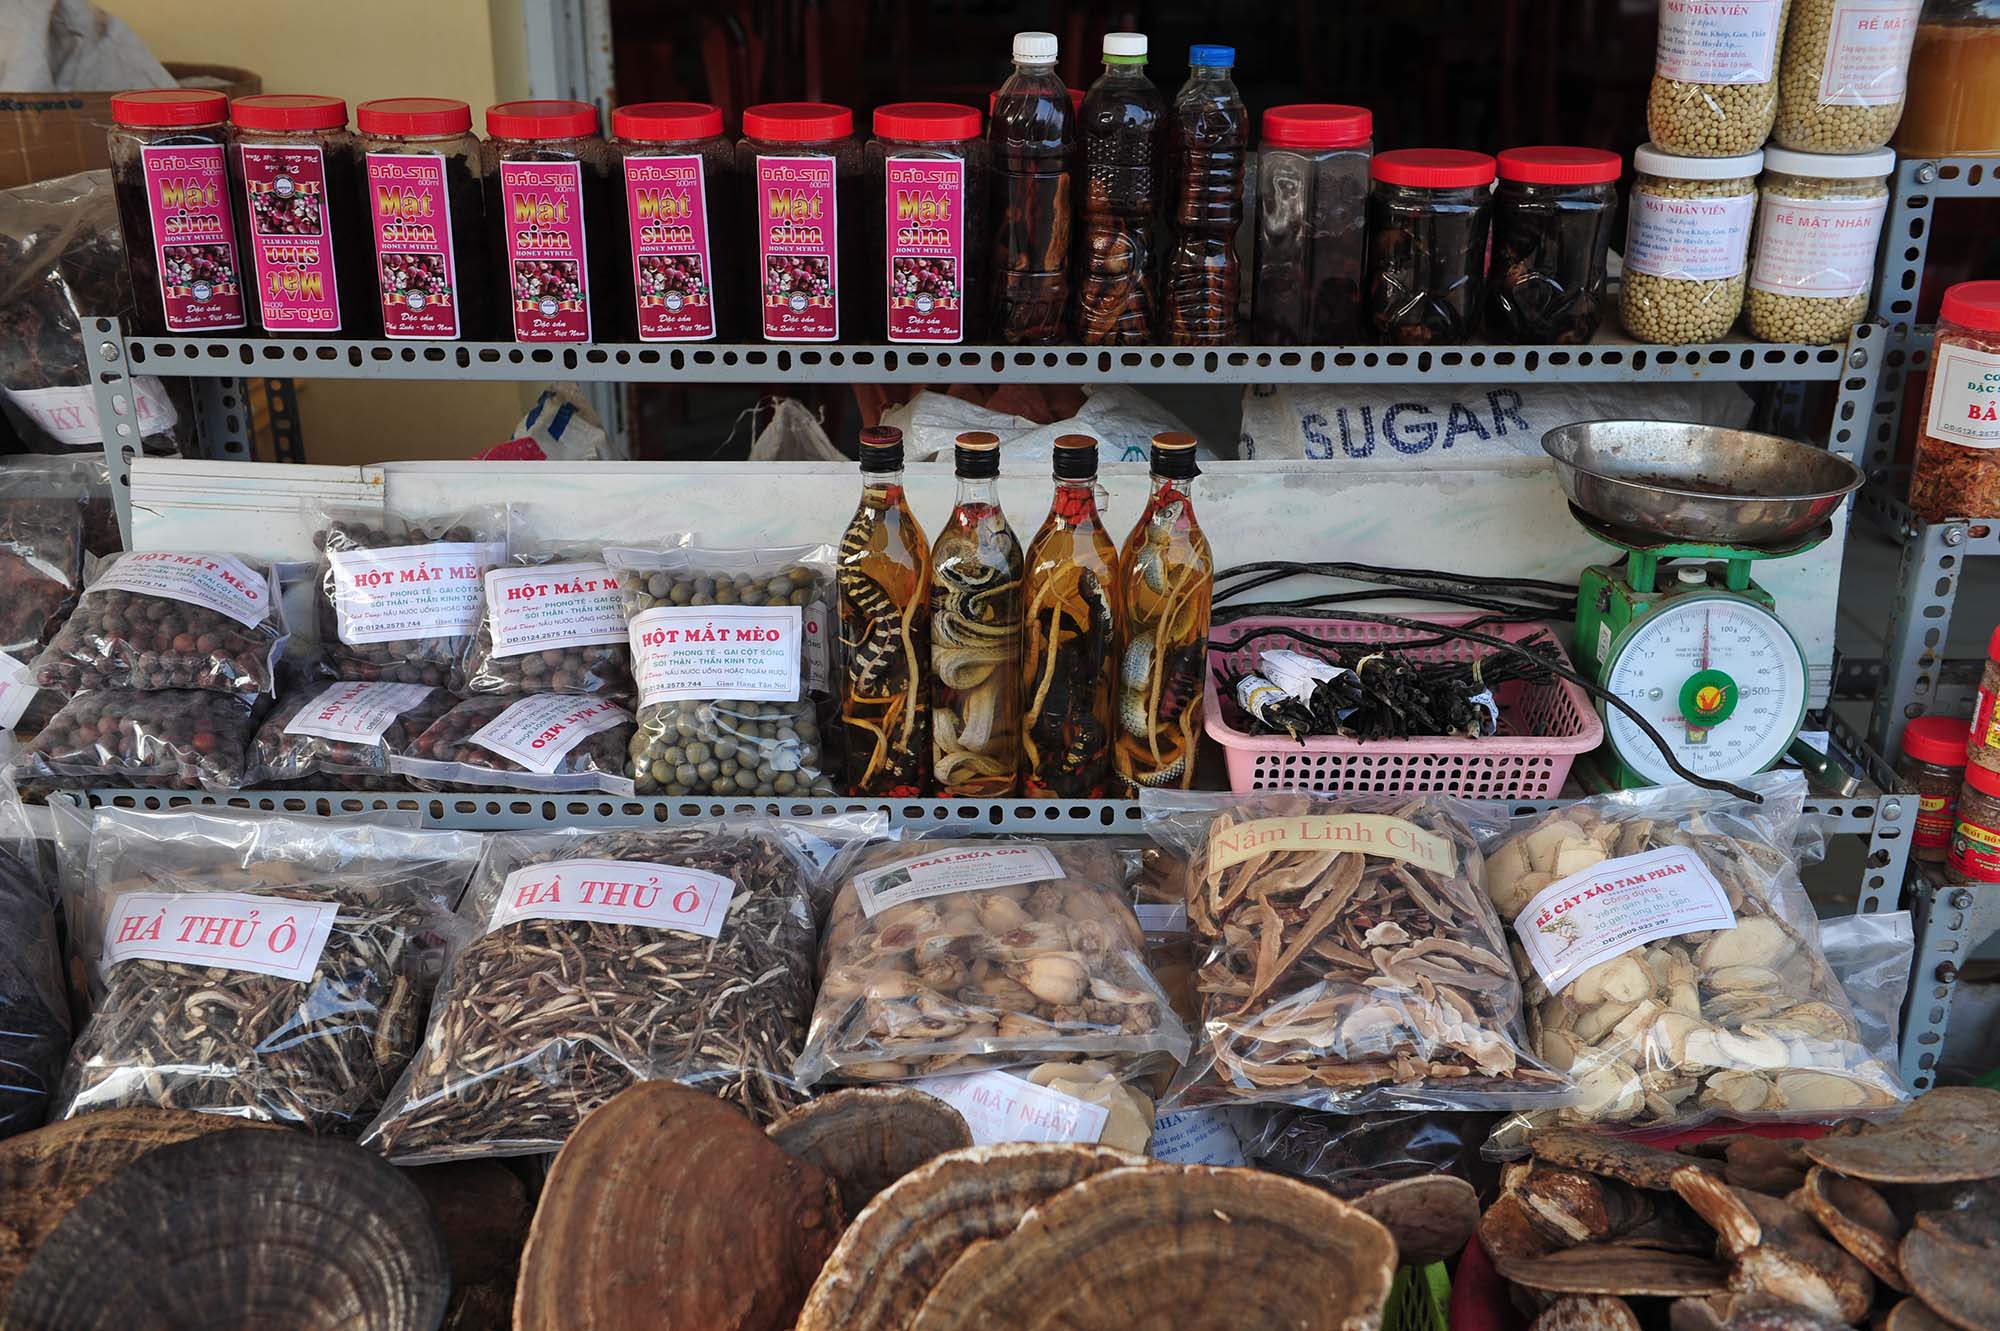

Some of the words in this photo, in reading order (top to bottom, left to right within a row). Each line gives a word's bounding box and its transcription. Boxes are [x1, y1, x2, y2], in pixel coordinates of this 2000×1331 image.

[1687, 4, 1717, 14] NHÂN
[1721, 4, 1749, 15] VIÊN
[377, 186, 434, 222] Mật
[514, 193, 569, 230] Mật
[636, 188, 692, 224] Mật
[769, 188, 823, 225] Mật
[897, 190, 951, 226] Mật
[1669, 204, 1698, 215] NHÂN
[1702, 205, 1726, 215] VIÊN
[381, 218, 436, 243] sim
[640, 220, 694, 245] sim
[770, 221, 823, 245] sim
[898, 223, 950, 247] sim
[1836, 217, 1871, 228] NHÂN
[516, 225, 571, 250] sim
[1302, 388, 1529, 460] SUGAR
[219, 569, 258, 600] MÈO
[354, 569, 394, 589] HỘT
[400, 562, 443, 582] MẮT
[451, 563, 483, 579] MÈ
[507, 584, 548, 600] HỘT
[554, 577, 597, 594] MẮT
[545, 600, 573, 608] PHONG
[642, 628, 679, 647] HỘT
[685, 622, 730, 643] MẮT
[736, 626, 780, 642] MÈO
[741, 649, 758, 657] CỘT
[760, 648, 785, 656] SỐNG
[1752, 687, 1770, 695] 500
[531, 723, 567, 749] MÈO
[1218, 823, 1287, 858] Nấm
[1301, 821, 1374, 842] Linh
[1385, 827, 1433, 861] Chi
[514, 874, 561, 908] HÀ
[578, 877, 661, 908] THỦ
[672, 885, 700, 913] Ô
[1554, 893, 1582, 914] CÂY
[1615, 873, 1647, 888] TAM
[1648, 863, 1687, 881] PHÂN
[1602, 893, 1631, 906] Công
[116, 908, 167, 944] HÀ
[177, 910, 261, 948] THỦ
[267, 915, 297, 953] Ô
[1019, 1103, 1078, 1137] NHÂN
